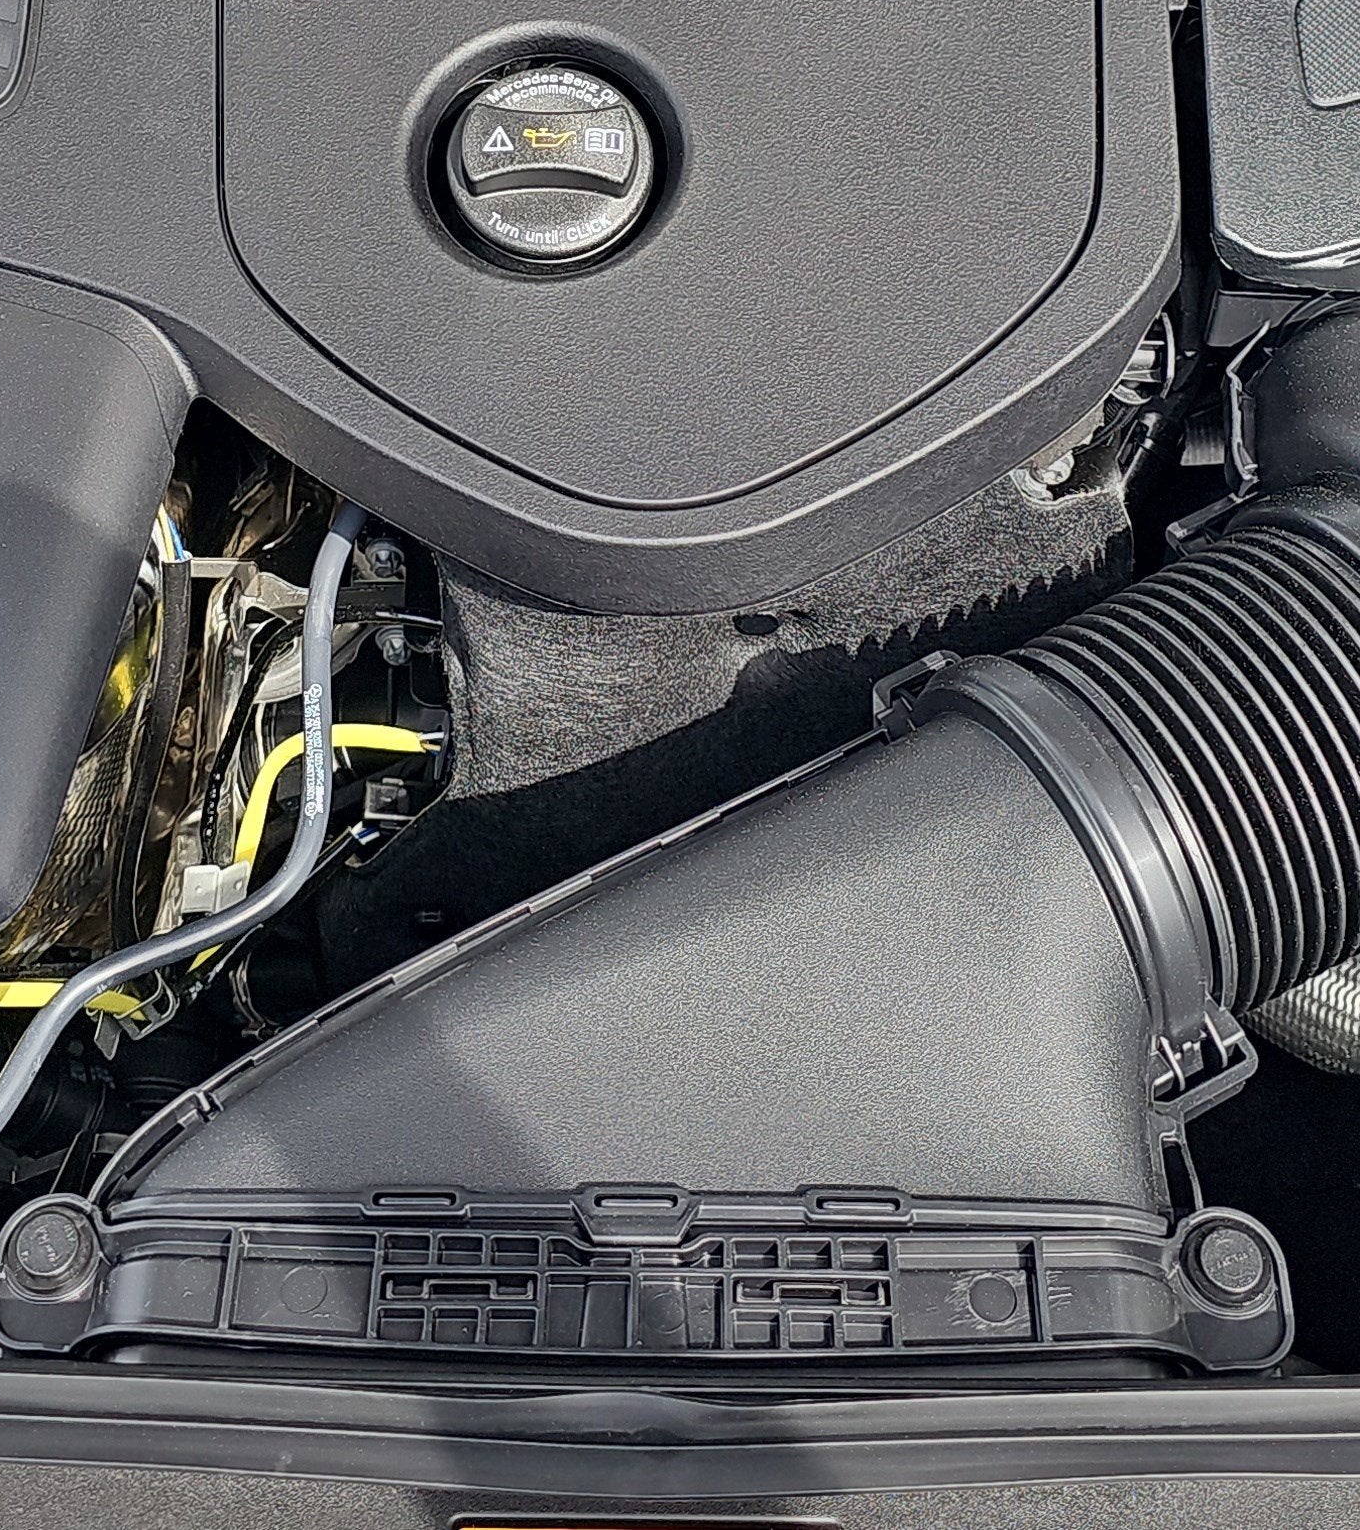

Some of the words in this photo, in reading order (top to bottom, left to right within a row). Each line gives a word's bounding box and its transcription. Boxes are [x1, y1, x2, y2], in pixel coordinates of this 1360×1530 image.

[486, 72, 600, 104] Mercedes-Benz
[599, 87, 620, 105] Oil
[504, 83, 604, 109] recommended
[488, 211, 519, 240] Turn
[525, 229, 559, 244] until
[566, 213, 612, 243] CLICK
